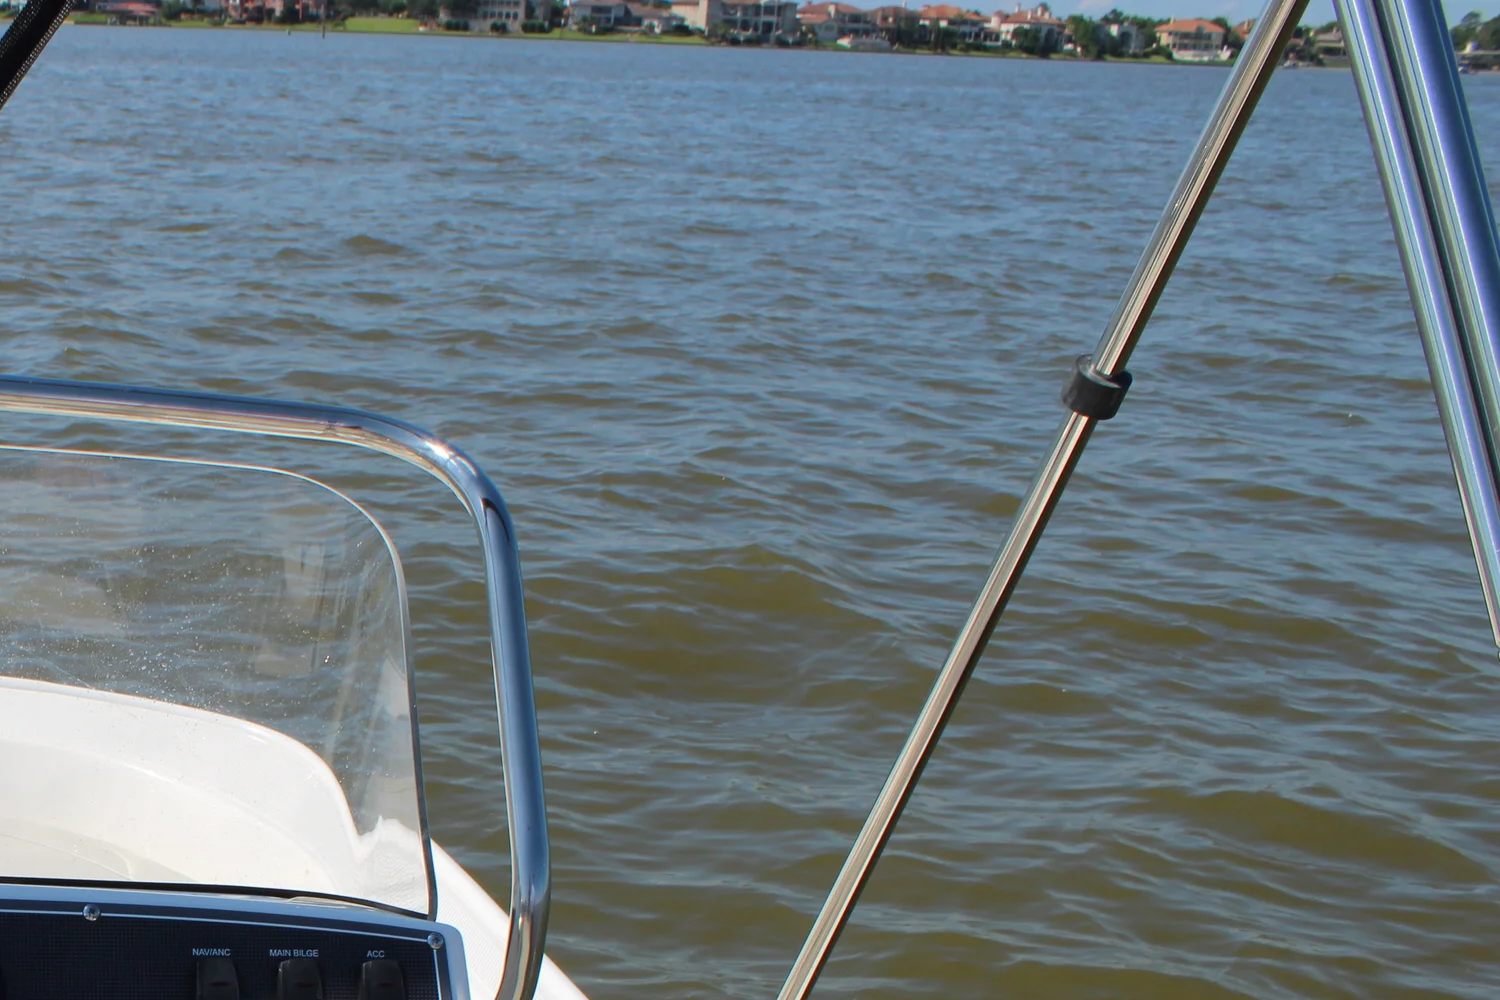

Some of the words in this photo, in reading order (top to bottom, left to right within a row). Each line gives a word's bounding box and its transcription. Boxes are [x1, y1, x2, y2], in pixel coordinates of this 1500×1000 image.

[192, 948, 231, 957] NAV/ANC
[269, 949, 292, 958] MAIN
[294, 949, 319, 958] BILGE
[366, 950, 385, 958] ACC
